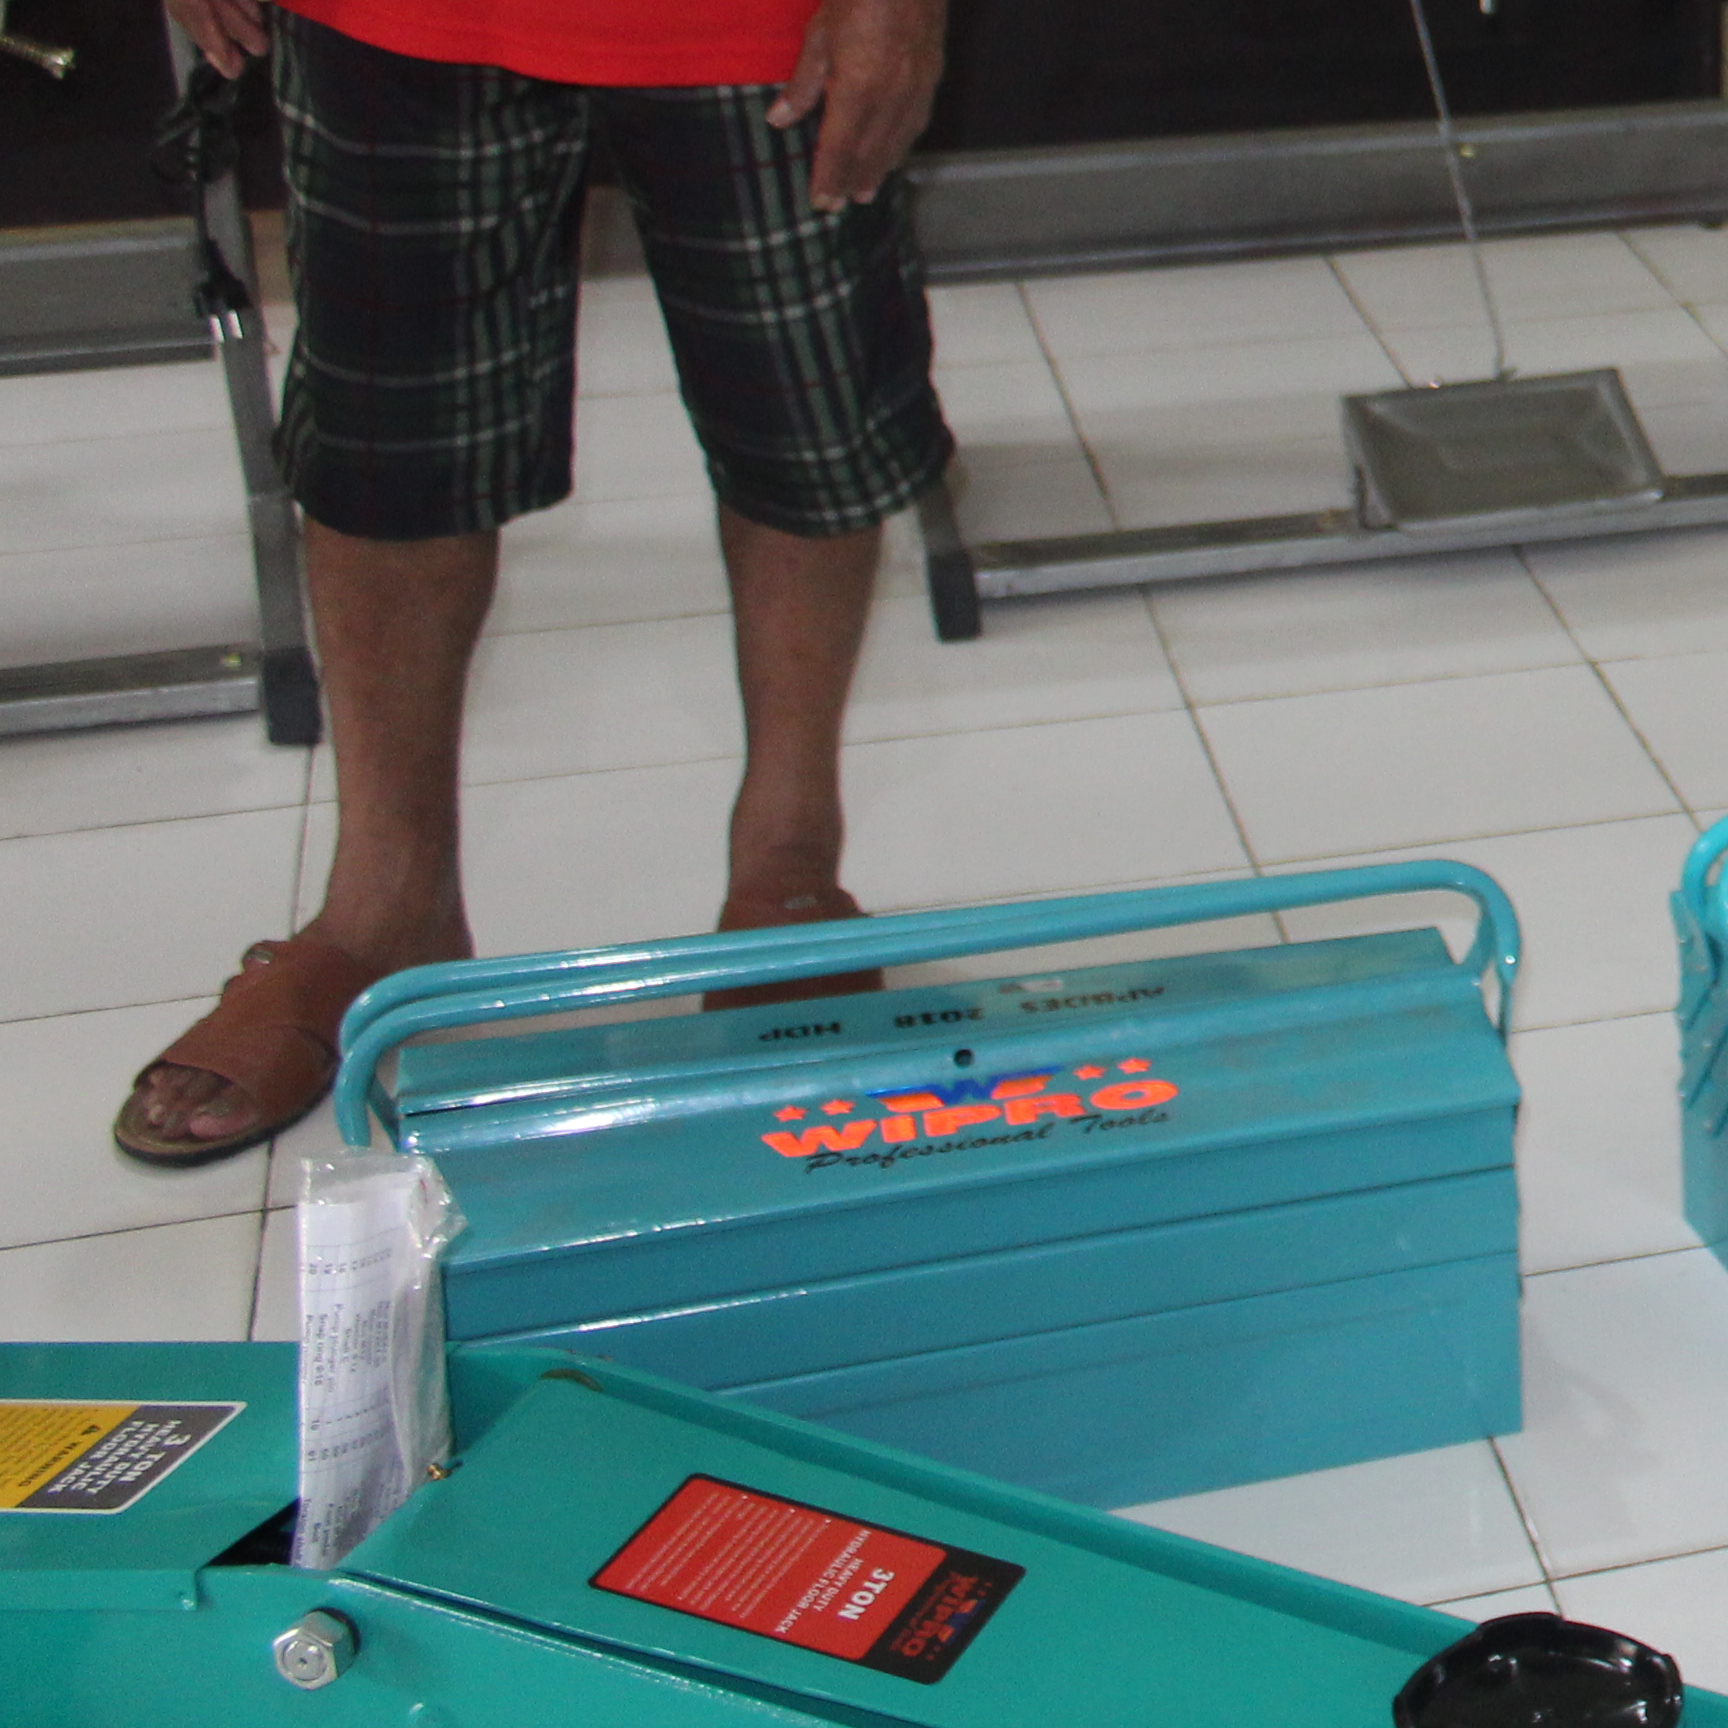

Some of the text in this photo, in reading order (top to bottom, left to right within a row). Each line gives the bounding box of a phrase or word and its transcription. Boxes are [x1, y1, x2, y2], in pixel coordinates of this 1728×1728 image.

[761, 1079, 1180, 1158] WIPRO
[805, 1109, 1172, 1174] Professional Tools
[71, 1422, 160, 1491] HYDRAULIC
[86, 1419, 182, 1495] HEAVY DUTY
[88, 1420, 145, 1462] FLOOR
[118, 1433, 192, 1483] 3 TON
[47, 1462, 91, 1494] JACK
[793, 1577, 830, 1609] FLOOR
[839, 1568, 896, 1620] 3TON
[772, 1608, 804, 1634] JACK
